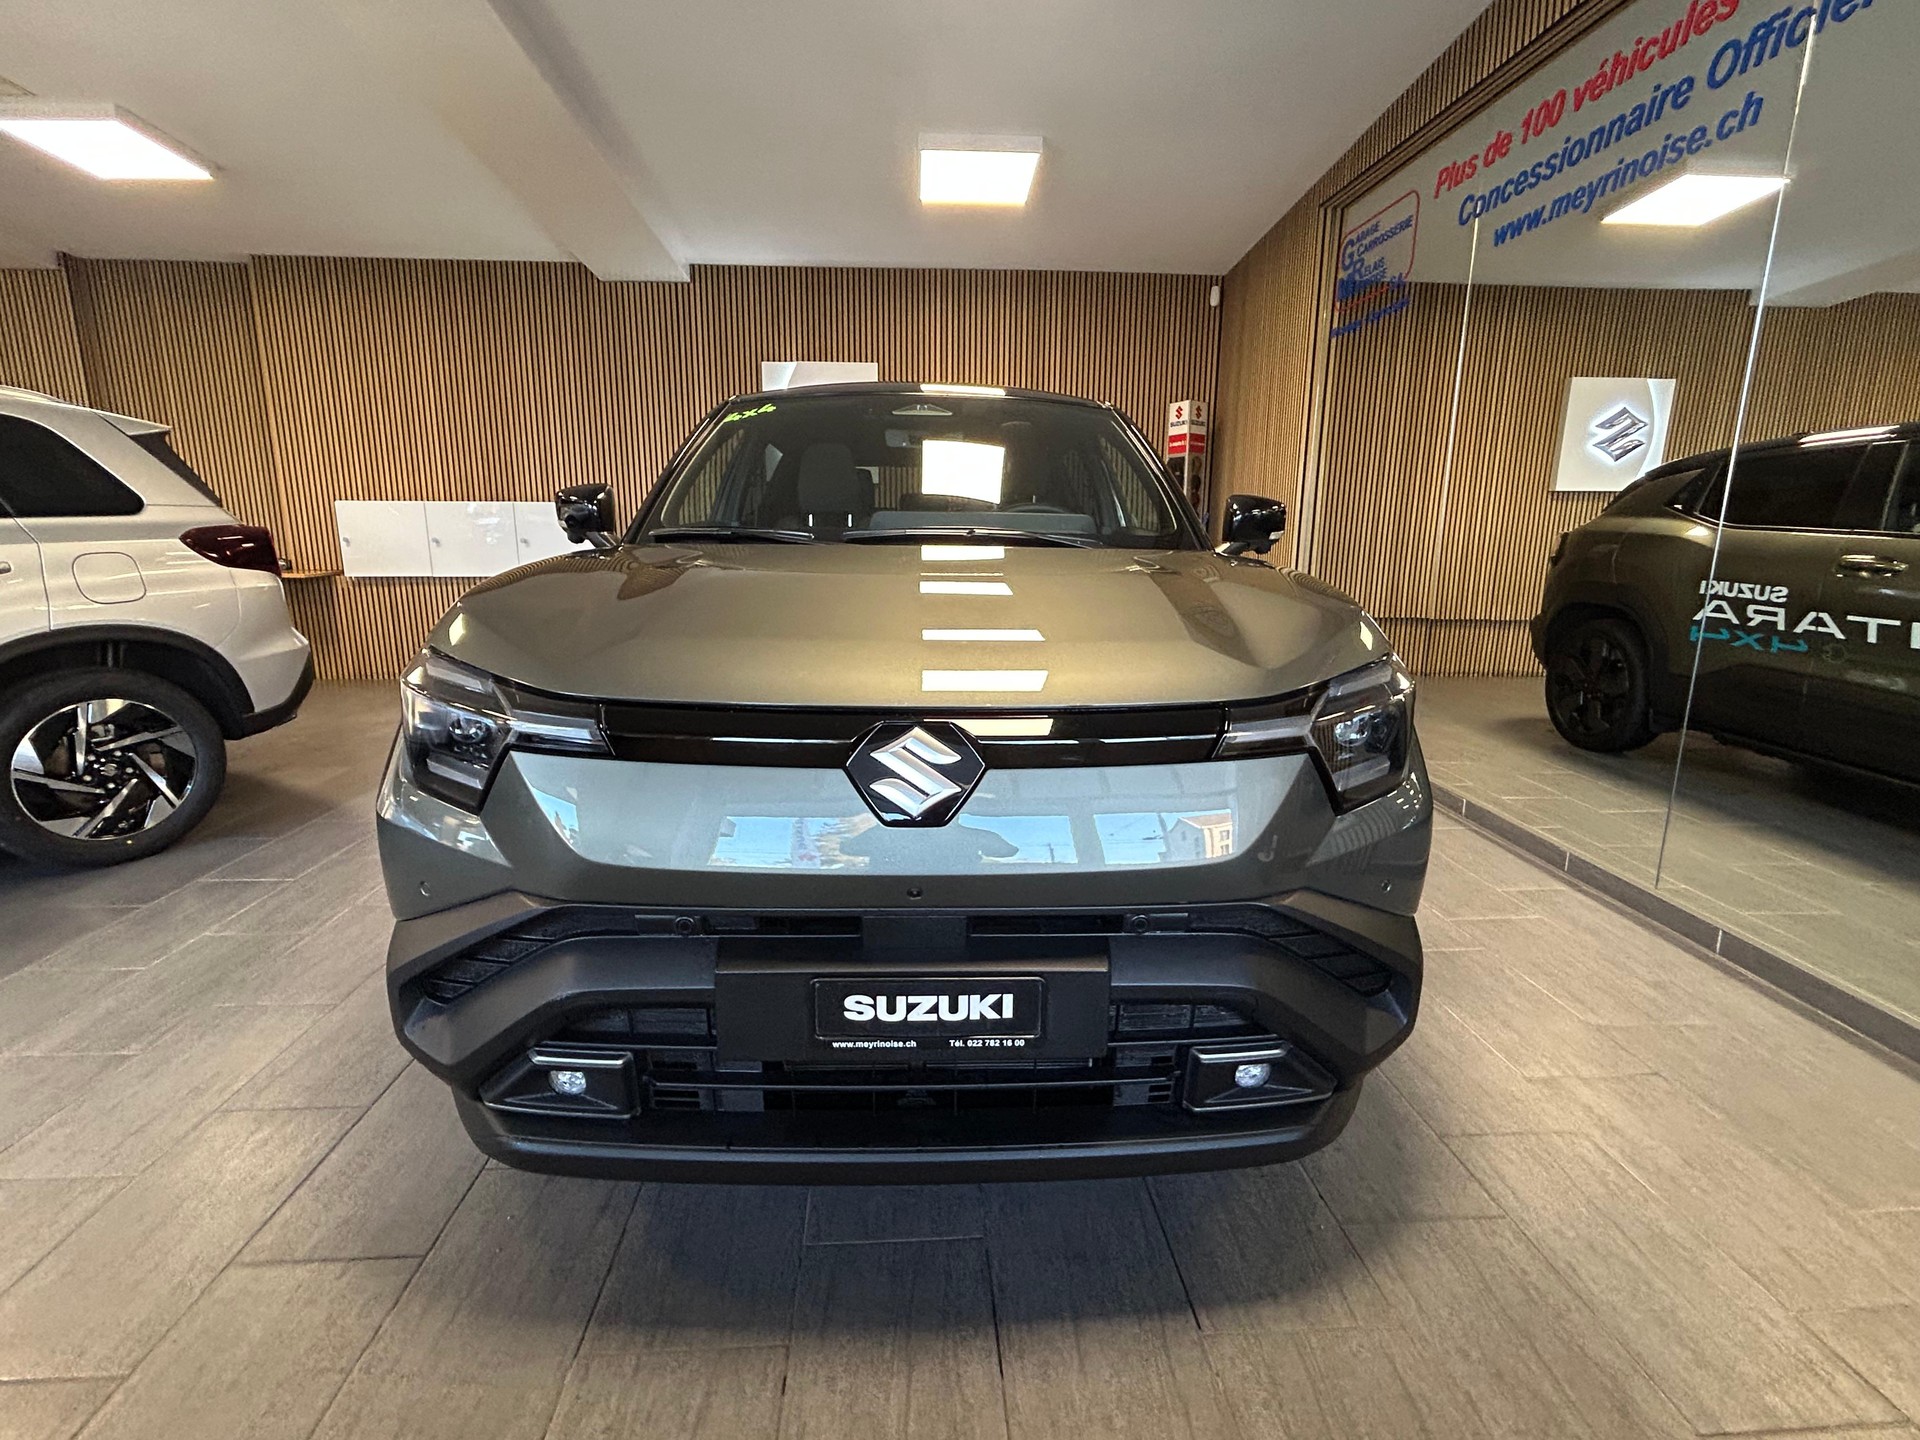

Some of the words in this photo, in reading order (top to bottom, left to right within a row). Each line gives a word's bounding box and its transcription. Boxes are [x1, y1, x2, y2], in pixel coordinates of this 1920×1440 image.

[1433, 153, 1480, 200] Plus
[1483, 130, 1514, 168] de
[1521, 88, 1568, 145] 100
[1573, 0, 1740, 112] véhicules
[1458, 75, 1695, 226] Concessionnaire
[1707, 0, 1873, 89] Officie
[1493, 91, 1764, 248] www.meyrinoise.ch
[832, 1040, 917, 1050] www.meyrinoise.ch
[967, 1039, 983, 1047] 022
[1014, 1039, 1026, 1047] 00
[843, 993, 1014, 1022] SUZUKI
